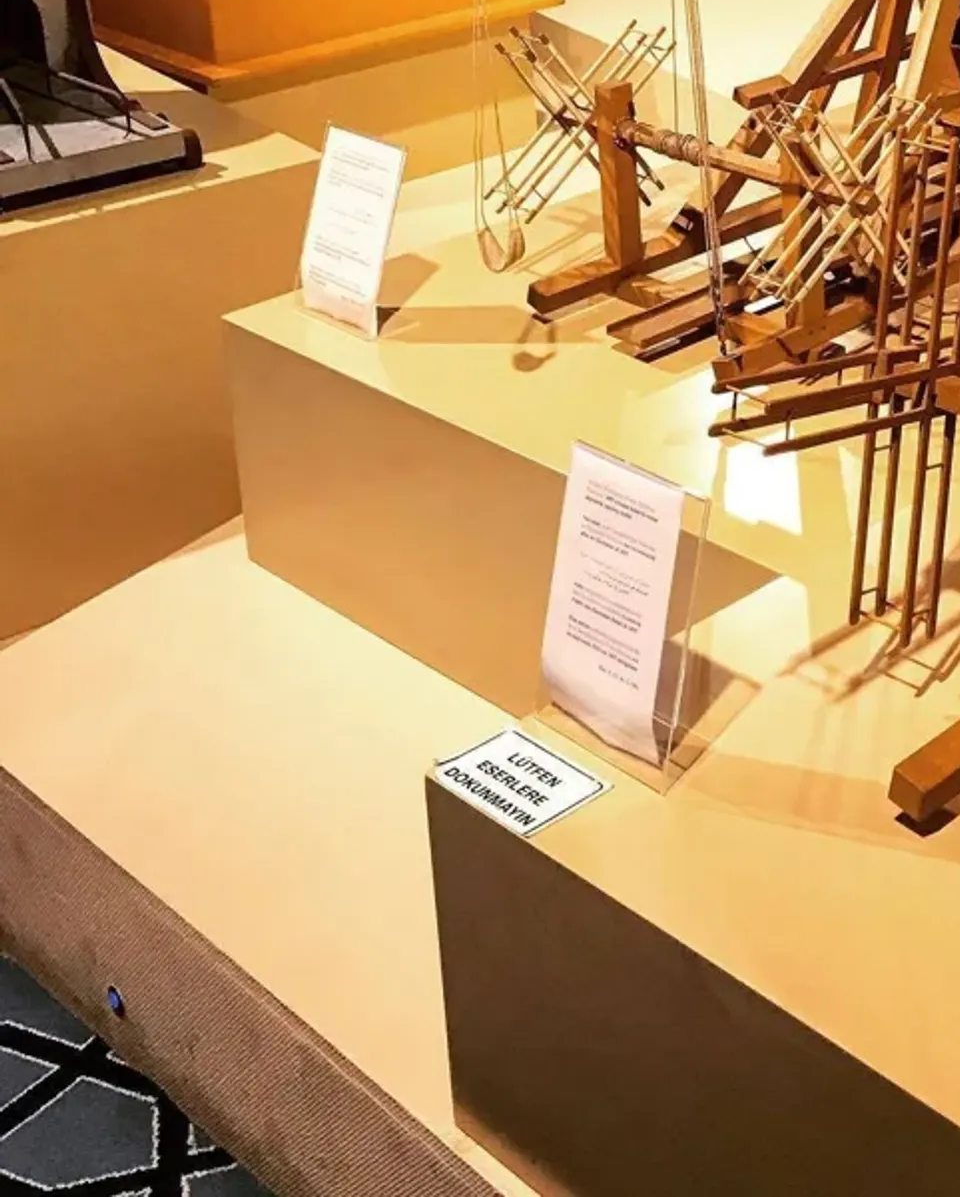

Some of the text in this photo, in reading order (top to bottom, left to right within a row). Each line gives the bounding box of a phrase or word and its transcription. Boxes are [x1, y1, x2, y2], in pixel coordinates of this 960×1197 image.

[476, 760, 549, 807] ESERLERE
[507, 752, 562, 788] LÜTFEN
[444, 767, 537, 827] DOKUNMAYIN
